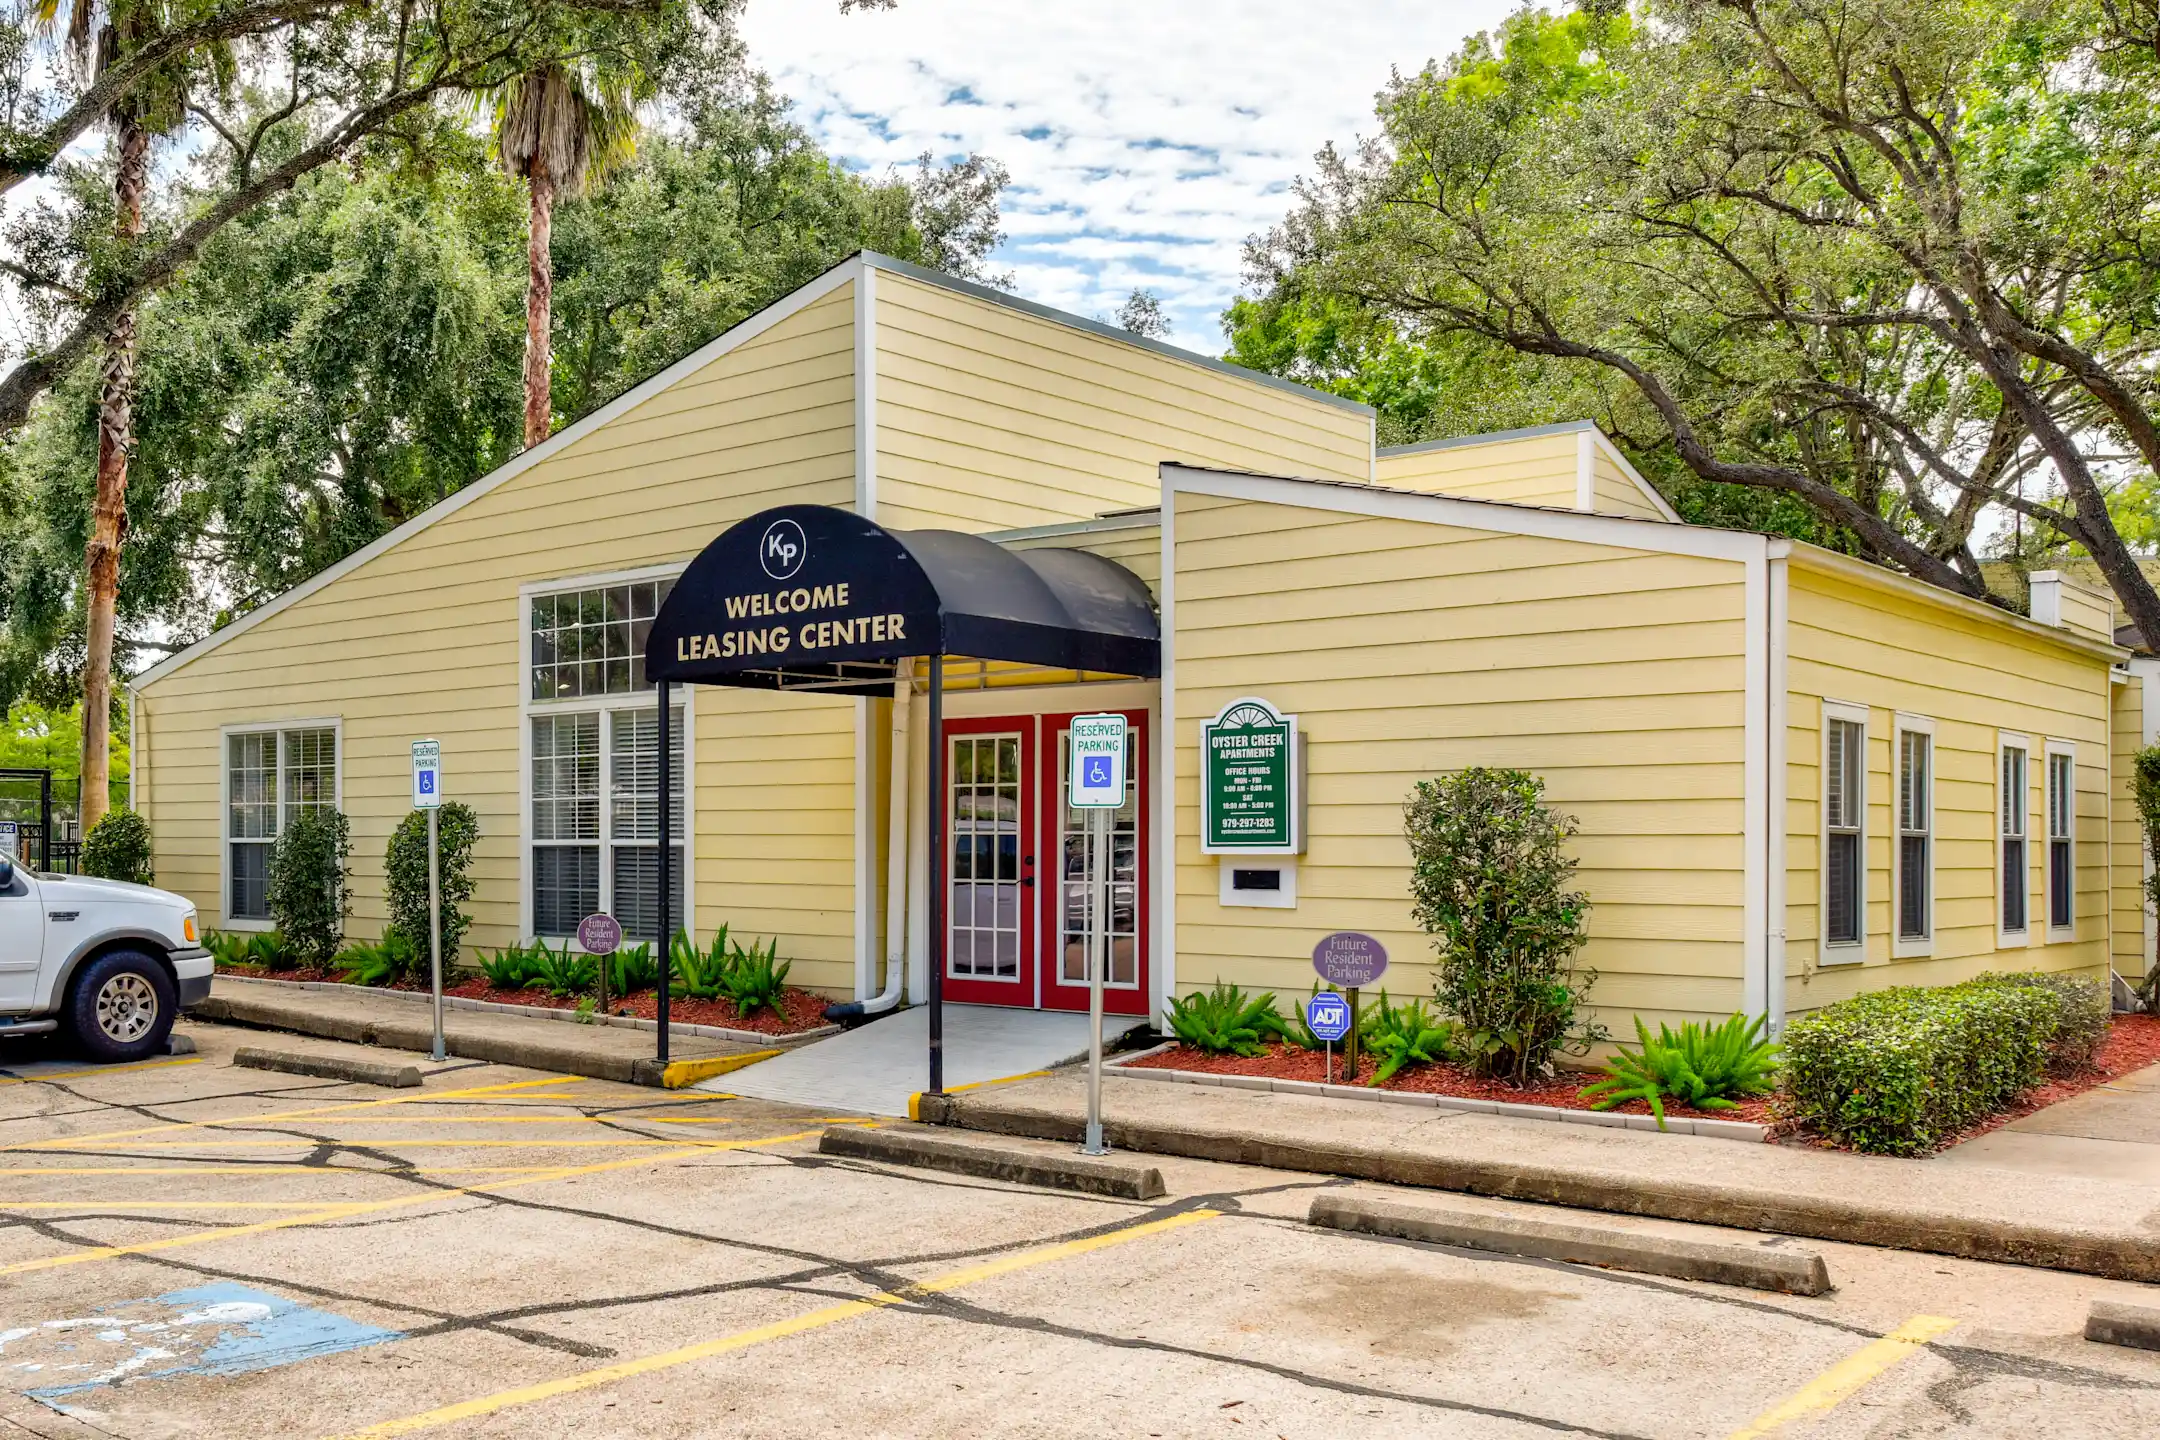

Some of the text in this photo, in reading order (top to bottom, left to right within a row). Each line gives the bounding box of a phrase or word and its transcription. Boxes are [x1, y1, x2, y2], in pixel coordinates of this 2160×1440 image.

[768, 533, 797, 567] KP
[724, 582, 849, 619] WELCOME
[677, 613, 906, 662] LEASING CENTER
[1075, 724, 1121, 736] RESERVED
[1078, 740, 1118, 751] PARKING
[1212, 733, 1283, 747] OYSTER CREEK
[414, 748, 437, 756] RESERVED
[1220, 747, 1275, 758] APARTMENTS
[416, 758, 436, 767] PARKING
[1225, 766, 1270, 775] OFFICE HOURS
[1222, 817, 1274, 827] 979-297-1283
[588, 917, 610, 928] Future
[585, 927, 613, 938] Resident
[586, 938, 612, 950] Parking
[1331, 936, 1367, 950] Future
[1325, 950, 1372, 964] Resident
[1327, 965, 1370, 981] Parking
[1314, 1007, 1343, 1024] ADT
